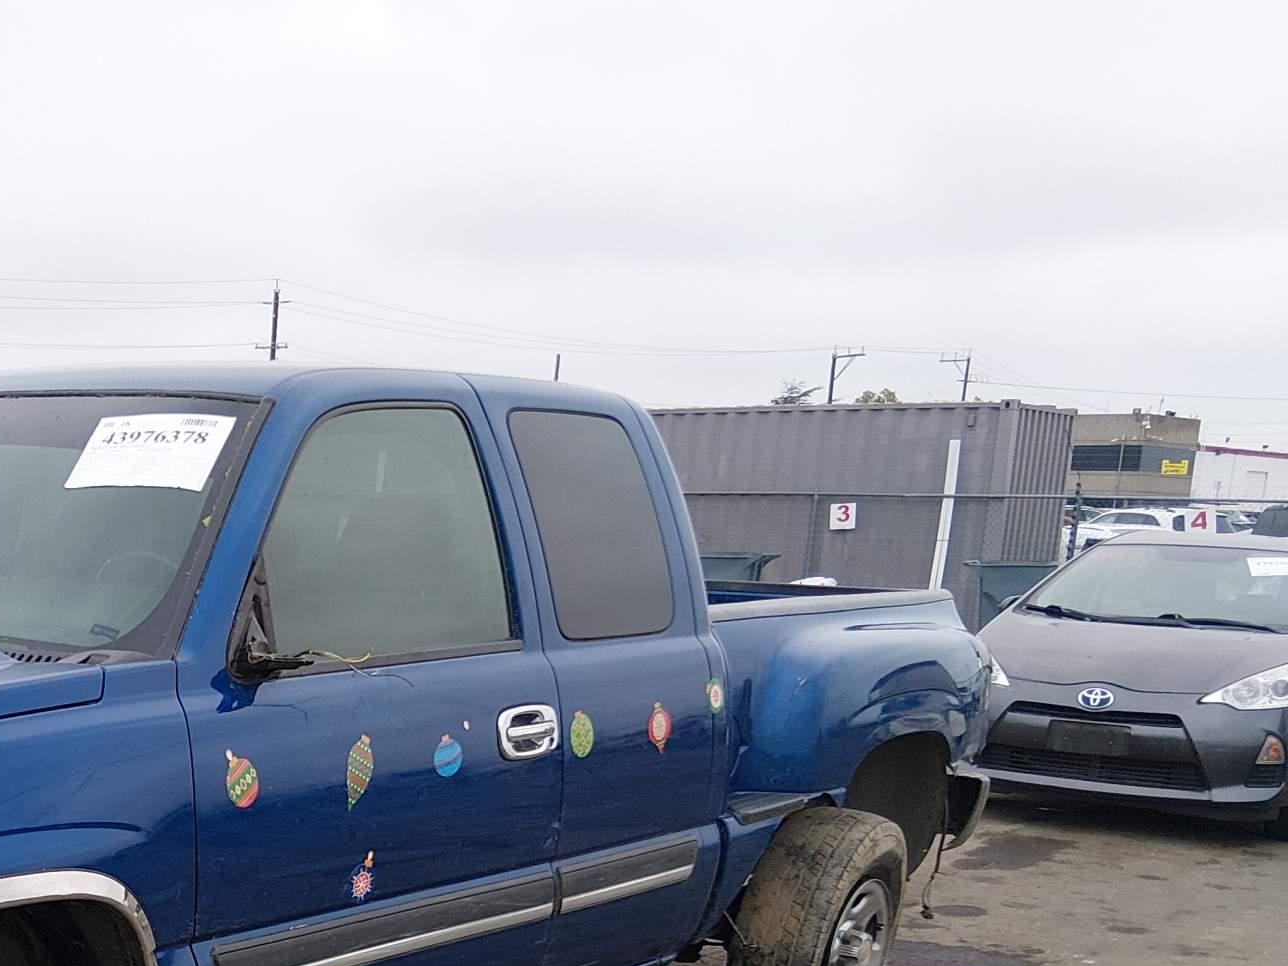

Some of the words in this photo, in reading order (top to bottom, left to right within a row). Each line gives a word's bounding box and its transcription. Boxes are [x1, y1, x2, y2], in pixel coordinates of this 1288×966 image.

[102, 430, 209, 445] 43976378
[836, 504, 850, 522] 3
[1191, 511, 1207, 529] 4
